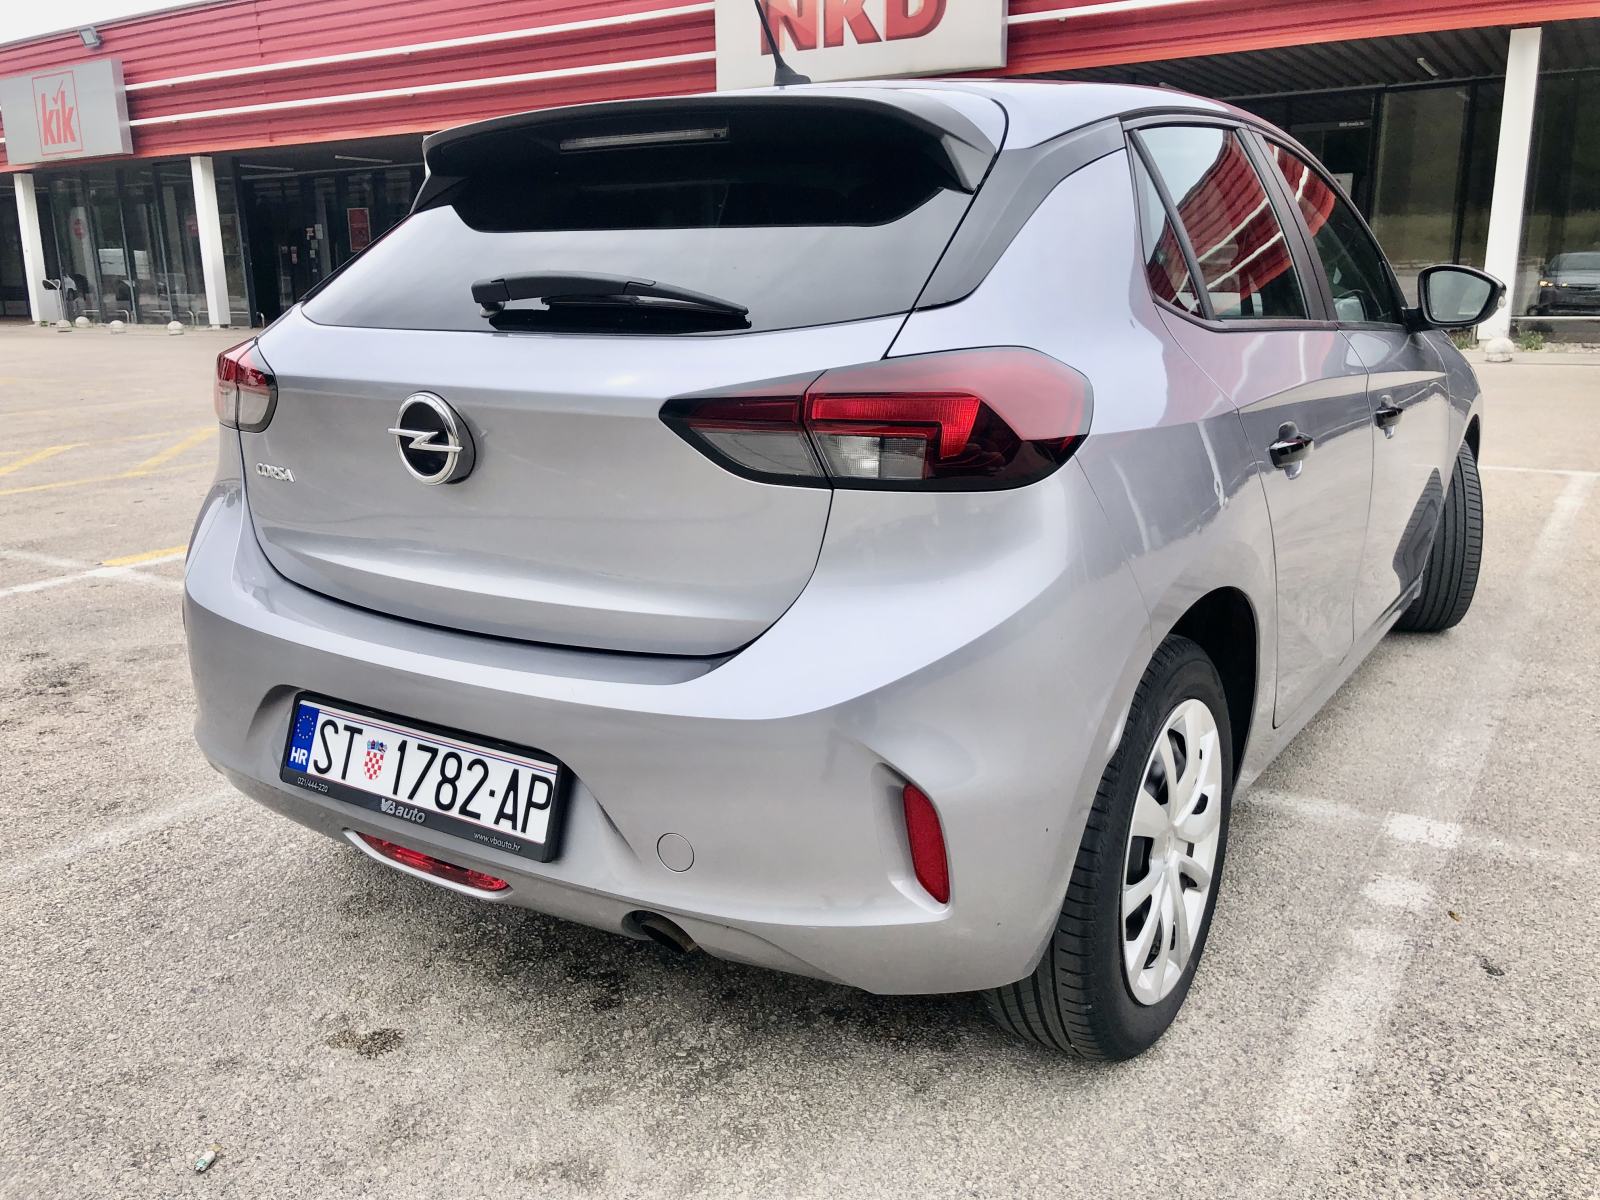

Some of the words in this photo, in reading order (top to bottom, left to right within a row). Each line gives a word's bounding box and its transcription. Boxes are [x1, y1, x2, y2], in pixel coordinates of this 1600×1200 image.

[761, 0, 947, 56] NKD
[256, 463, 295, 482] CORSA
[290, 746, 308, 766] HR
[313, 719, 364, 780] ST
[473, 832, 521, 852] www.vbauto.hr
